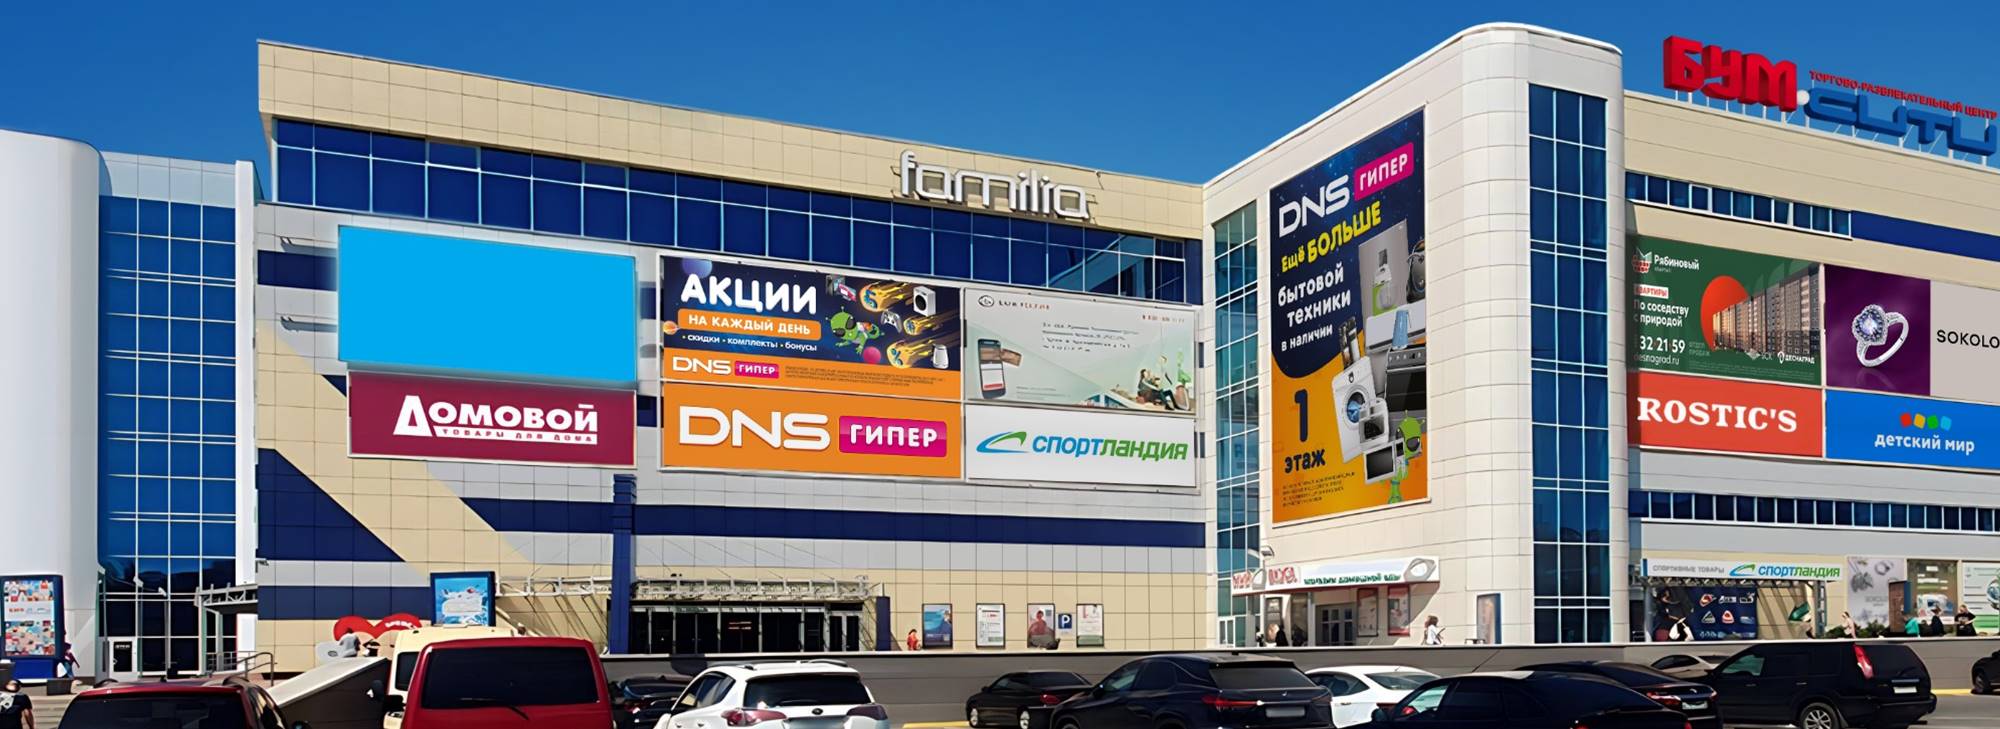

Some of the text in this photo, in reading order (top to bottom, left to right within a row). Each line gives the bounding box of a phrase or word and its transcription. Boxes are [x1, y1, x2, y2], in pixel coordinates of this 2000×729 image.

[1663, 35, 1797, 112] БУМ
[1965, 106, 1998, 120] ЦЕНТР
[900, 149, 1089, 219] familia
[1359, 153, 1408, 191] ГИПЕР
[1278, 174, 1350, 238] DNS
[1307, 200, 1381, 263] БОЛЬШЕ
[1654, 254, 1700, 271] Рябиновый
[680, 273, 817, 315] АКЦИИ
[1278, 261, 1344, 307] бытовой
[1286, 289, 1351, 328] техники
[1640, 313, 1683, 327] природой
[1647, 302, 1690, 318] соседству
[688, 314, 811, 335] НА КАЖДЫЙ ДЕНЬ
[687, 334, 817, 352] скидки комплекты бонусы
[1281, 324, 1333, 352] в наличии
[672, 356, 732, 375] DNS
[738, 364, 776, 375] ГИПЕР
[1294, 388, 1309, 442] 1
[1637, 396, 1798, 433] ROSTIC'S
[442, 428, 592, 442] ТОВАРЫ ДЛЯ ДОМА
[679, 405, 831, 451] DNS
[850, 424, 938, 448] ГИПЕР
[1032, 435, 1189, 461] спортландия
[1874, 433, 1975, 453] детский мир
[1284, 449, 1326, 474] этаж
[1758, 564, 1841, 578] спортландия
